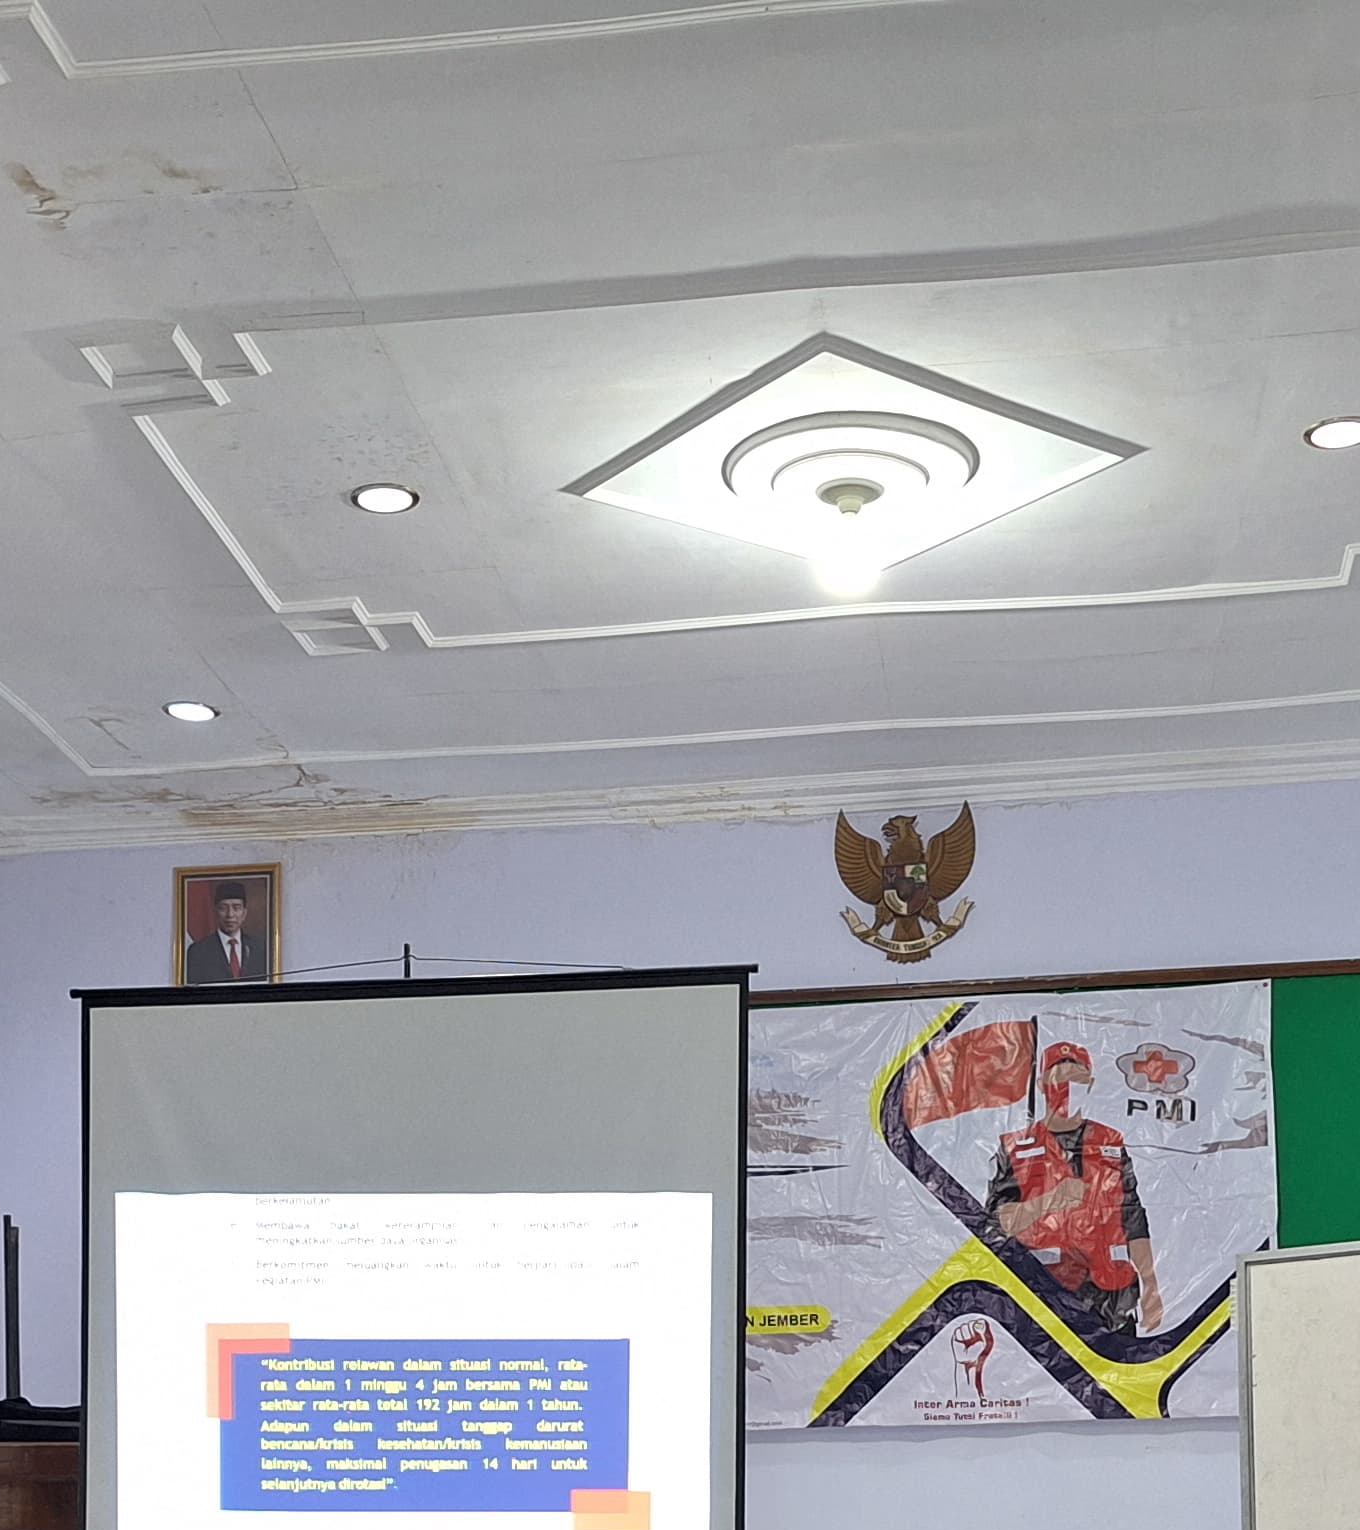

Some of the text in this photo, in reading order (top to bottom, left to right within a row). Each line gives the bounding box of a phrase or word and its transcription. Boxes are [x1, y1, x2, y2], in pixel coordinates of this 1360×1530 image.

[1127, 1098, 1197, 1122] PMI
[759, 1313, 820, 1327] JEMBER
[342, 1359, 395, 1371] relawan
[402, 1358, 442, 1371] dalam
[449, 1358, 491, 1371] situasi
[499, 1358, 549, 1373] normal,
[260, 1378, 288, 1392] rata
[295, 1378, 336, 1391] dalam
[360, 1378, 407, 1394] minggu
[415, 1378, 425, 1391] 4
[431, 1378, 458, 1394] jam
[465, 1378, 521, 1391] bersama
[528, 1378, 552, 1391] PMI
[559, 1378, 589, 1391] atau
[260, 1398, 306, 1411] sekitar
[312, 1398, 370, 1411] rata-rata
[376, 1398, 409, 1411] total
[416, 1398, 441, 1411] 192
[446, 1398, 472, 1414] jam
[479, 1398, 519, 1411] dalam
[914, 1399, 943, 1409] Inter
[946, 1399, 976, 1409] Arma
[980, 1397, 1022, 1408] Caritas
[260, 1419, 310, 1434] Adapun
[333, 1419, 373, 1432] dalam
[396, 1419, 438, 1432] situasi
[536, 1419, 584, 1432] darurat
[260, 1437, 354, 1451] bencana/krisis
[505, 1437, 588, 1451] kemanusiaan
[261, 1457, 588, 1473] lainnya, maksimal penugasan 14 hari untuk
[260, 1477, 336, 1493] selanjutnya
